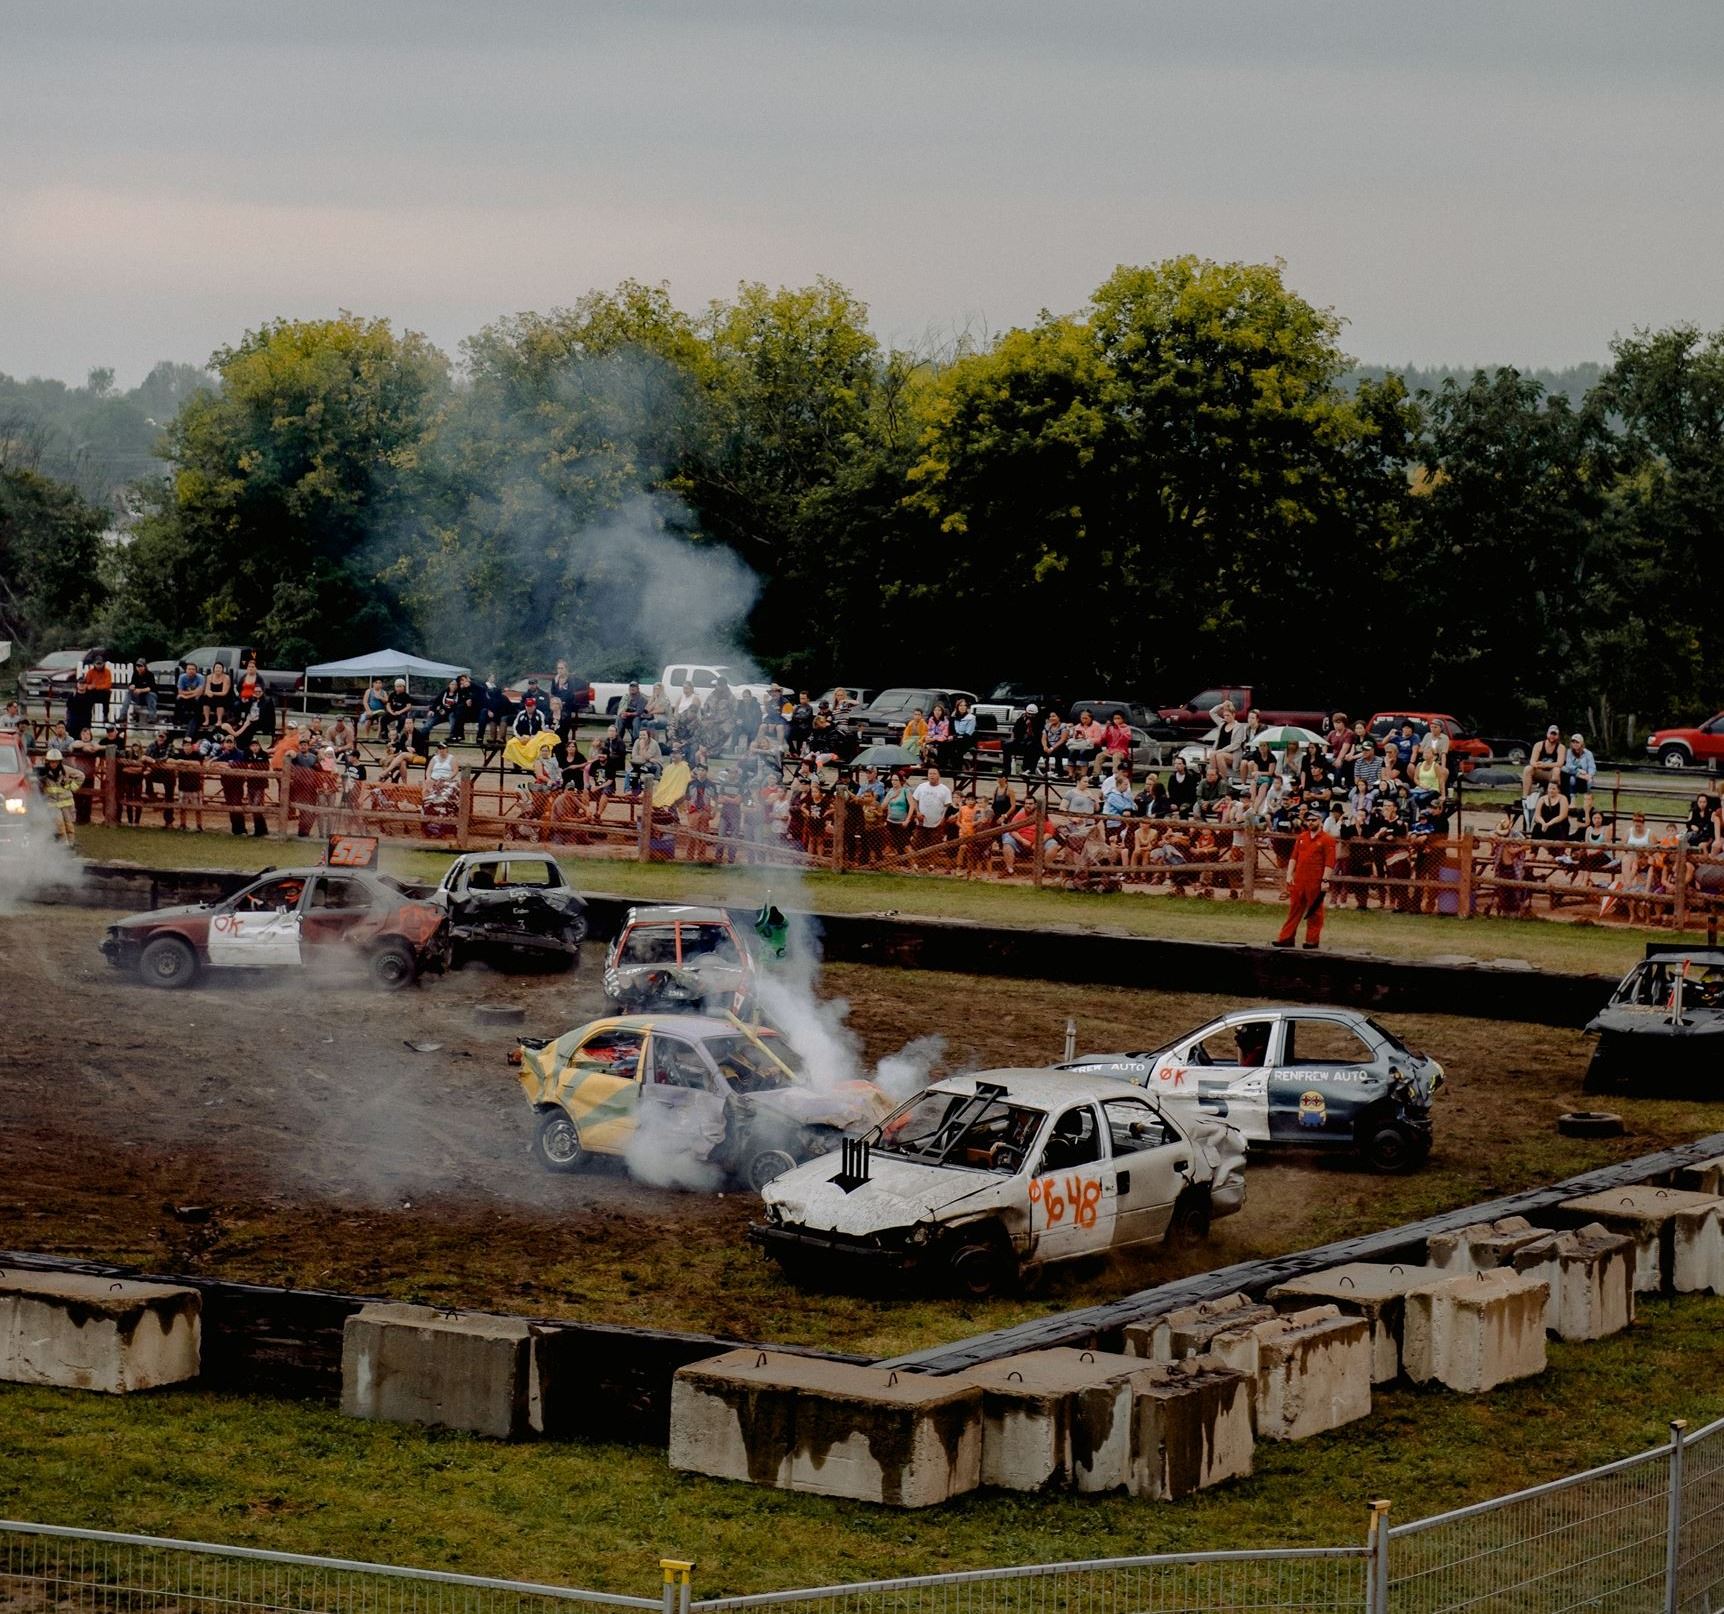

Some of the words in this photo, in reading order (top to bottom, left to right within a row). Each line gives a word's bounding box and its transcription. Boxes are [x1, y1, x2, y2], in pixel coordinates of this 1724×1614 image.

[1111, 1063, 1145, 1072] AUTO
[1273, 1070, 1329, 1082] RENFREW
[1333, 1069, 1368, 1081] AUTO
